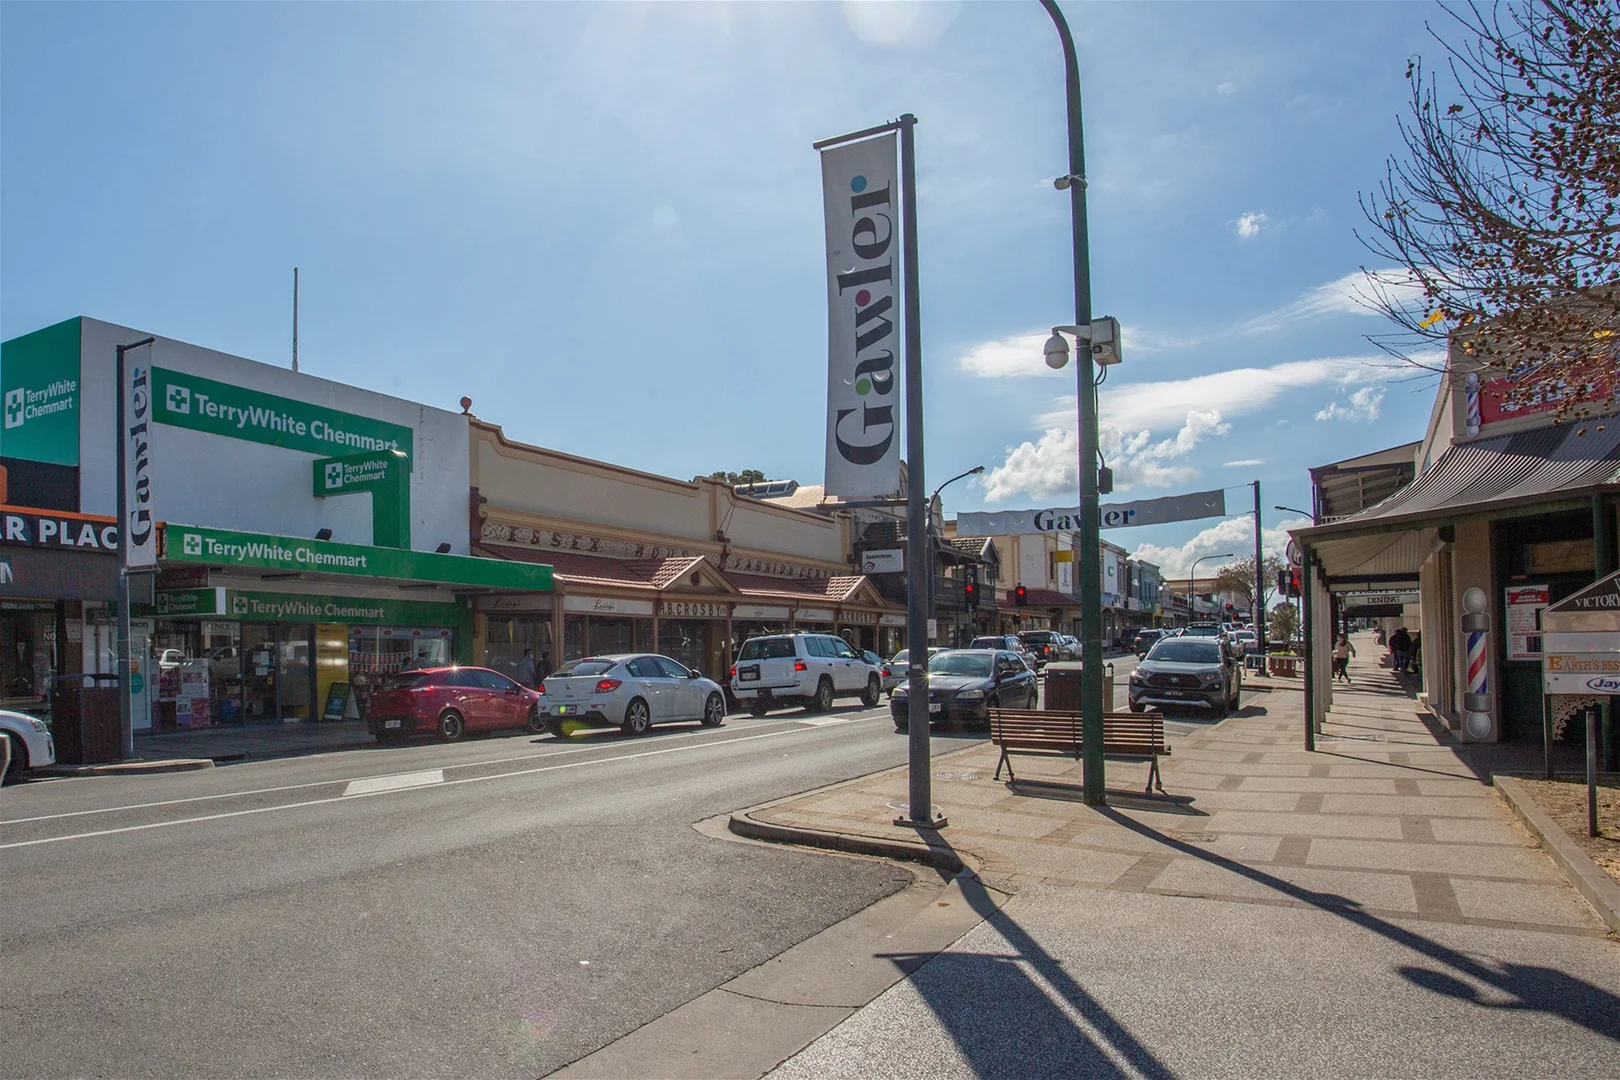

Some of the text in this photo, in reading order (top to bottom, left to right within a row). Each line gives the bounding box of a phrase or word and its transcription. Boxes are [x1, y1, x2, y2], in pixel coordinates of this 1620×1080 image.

[834, 175, 895, 466] Gawler
[25, 379, 77, 404] TerryWhite
[25, 398, 73, 420] Chemmart
[194, 392, 399, 452] TerryWhite Chemmart
[130, 367, 152, 547] Gawler
[343, 459, 388, 475] TerryWhite
[343, 470, 386, 484] Chemmart
[0, 516, 118, 550] R PLAC
[204, 537, 367, 568] TerryWhite Chemmart
[250, 600, 385, 619] TerryWhite Chemmart
[1366, 595, 1400, 604] DINING
[1602, 659, 1620, 671] BES
